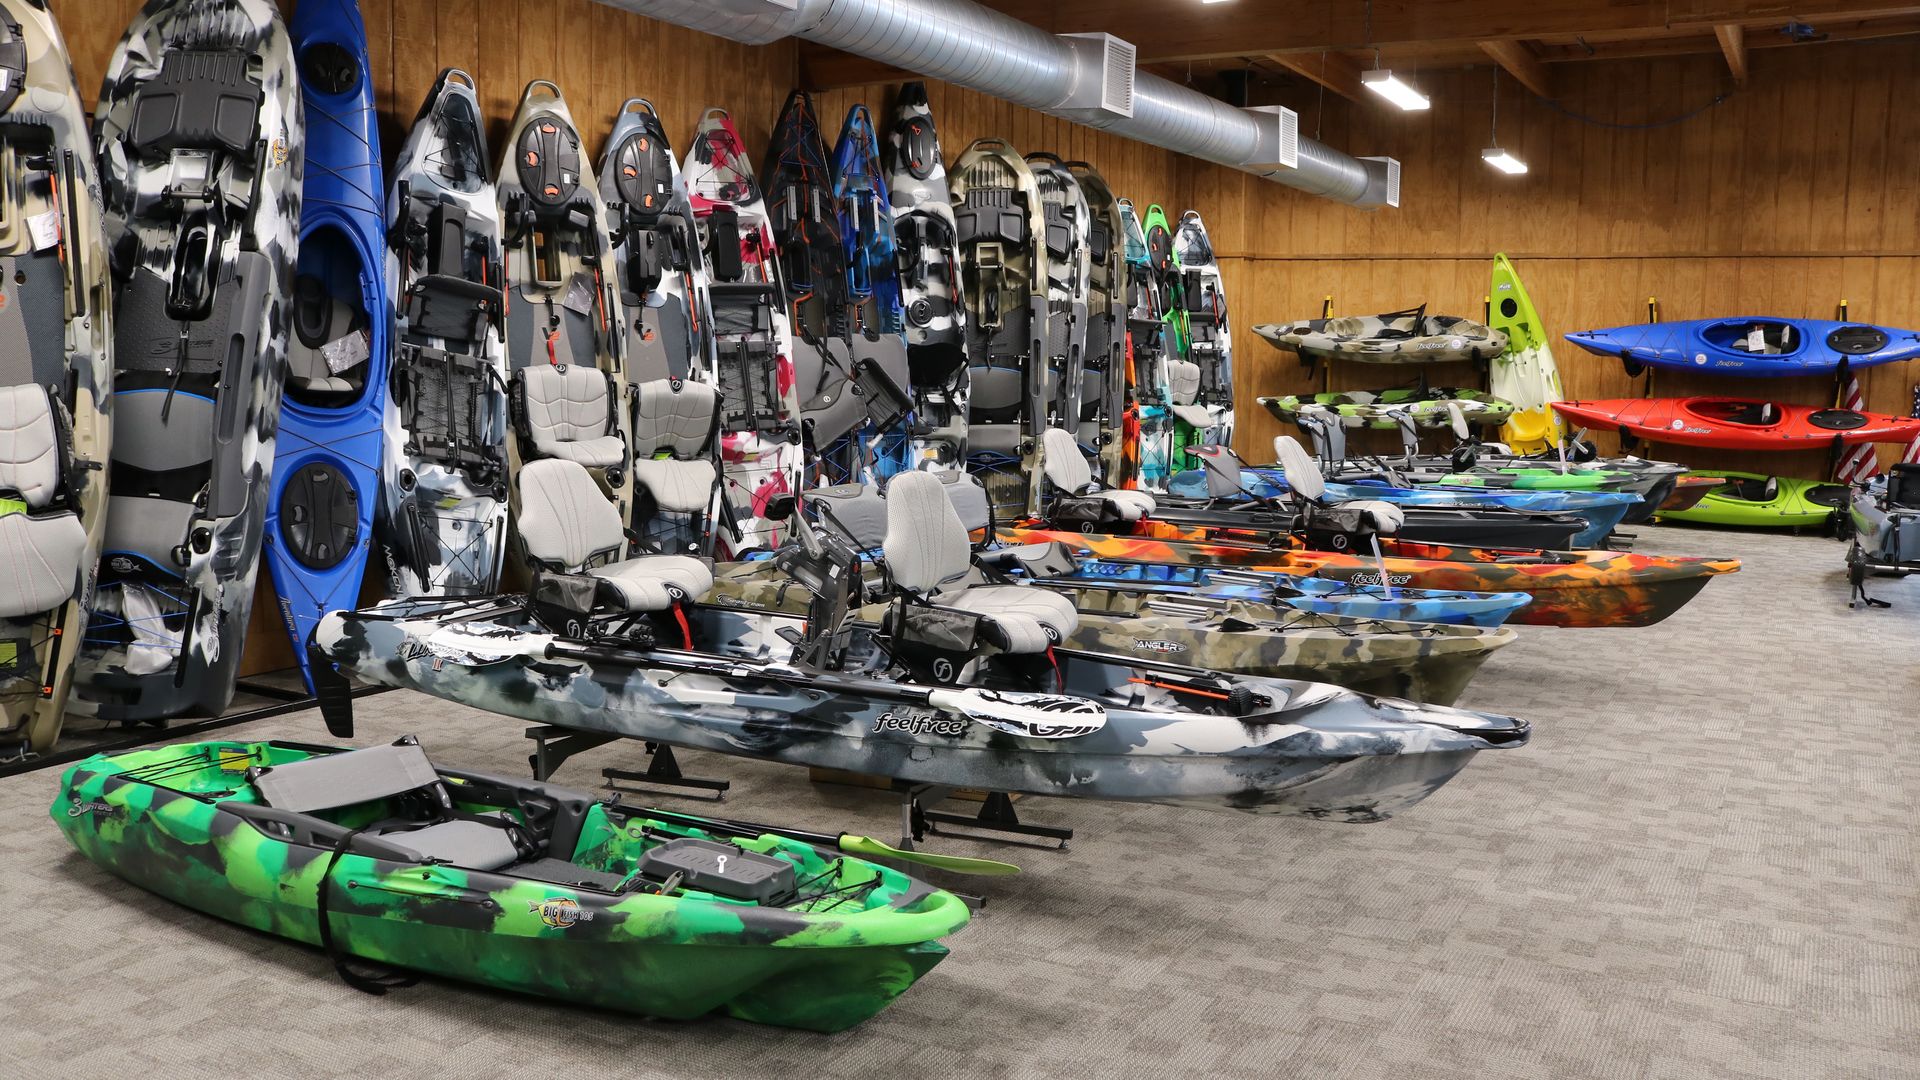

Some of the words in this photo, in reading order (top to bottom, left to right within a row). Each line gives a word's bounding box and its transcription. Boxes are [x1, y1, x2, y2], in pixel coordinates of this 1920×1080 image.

[383, 543, 404, 595] MOKEN
[1136, 640, 1180, 652] ANGLER
[872, 712, 965, 735] feelfree
[543, 905, 558, 918] BIG
